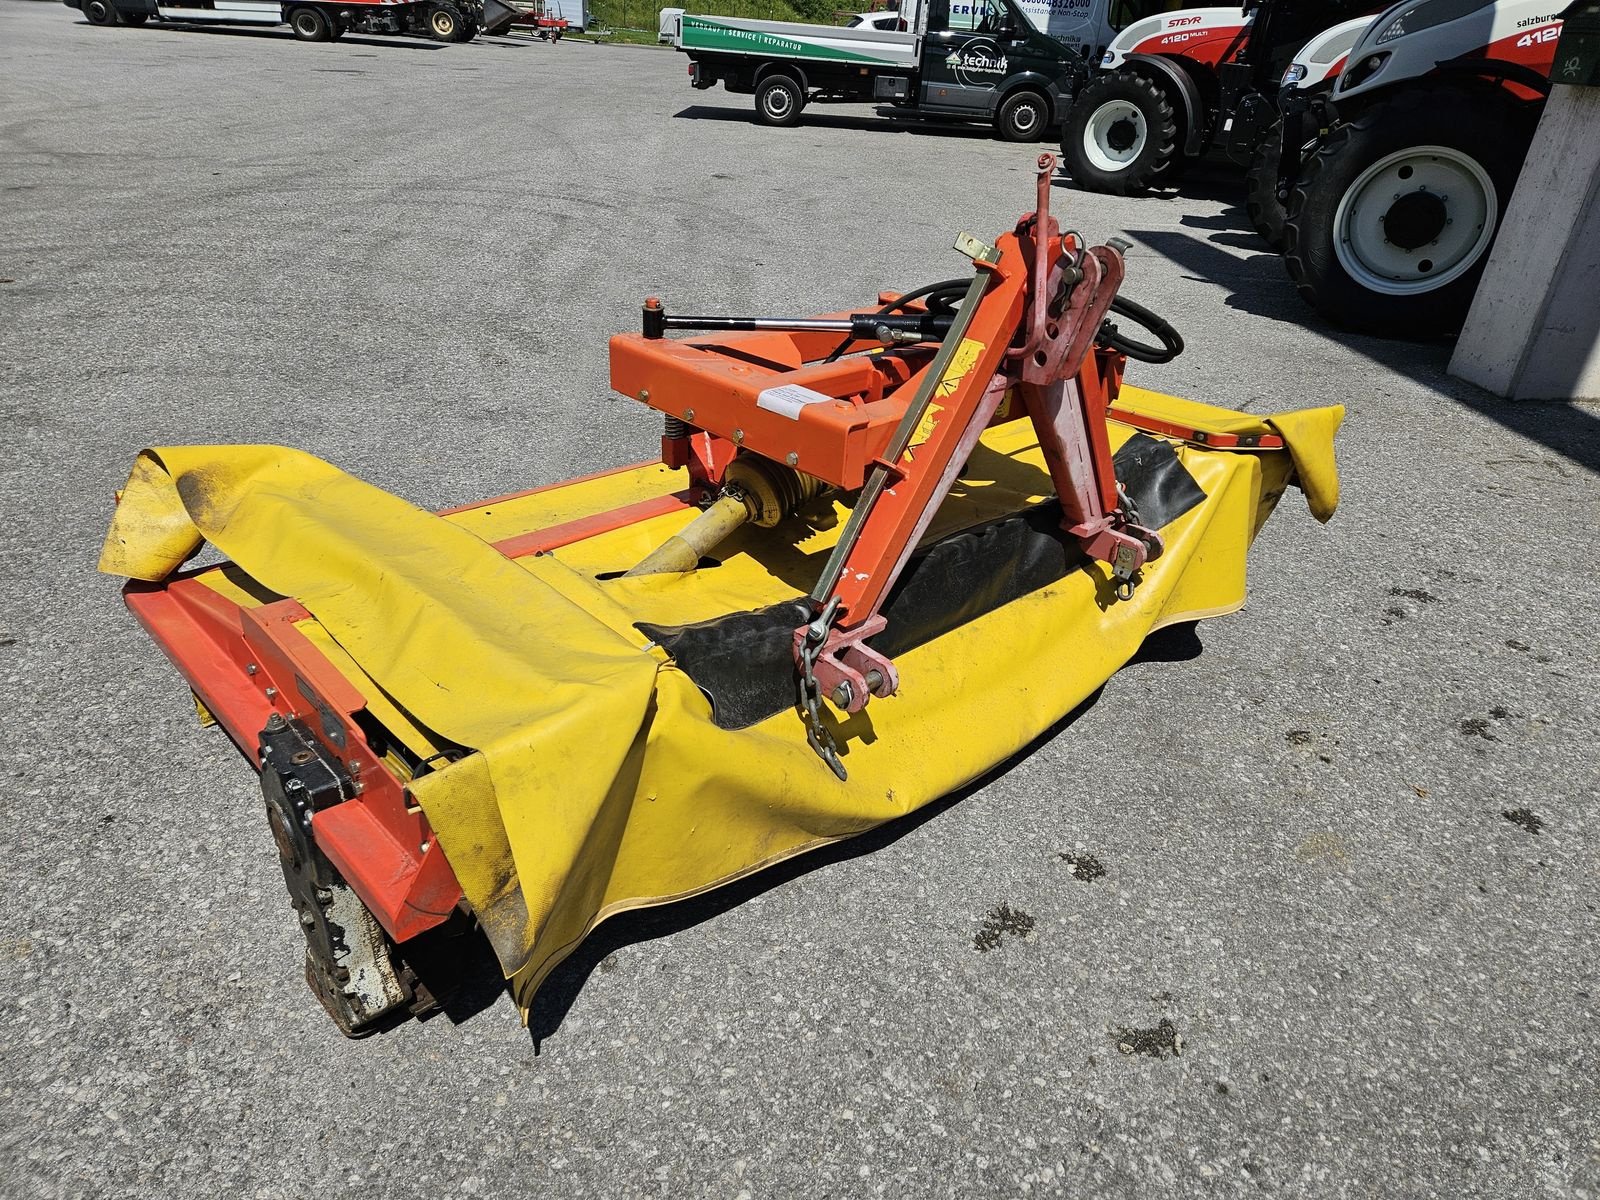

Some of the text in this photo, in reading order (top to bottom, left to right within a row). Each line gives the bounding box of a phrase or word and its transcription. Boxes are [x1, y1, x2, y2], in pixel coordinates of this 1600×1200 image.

[1057, 9, 1089, 19] Non-Stop
[1168, 17, 1201, 28] STEYR
[691, 21, 802, 50] VERKAUF SERVICE REPARATUR
[1162, 34, 1189, 44] 4120
[963, 53, 1008, 69] technik
